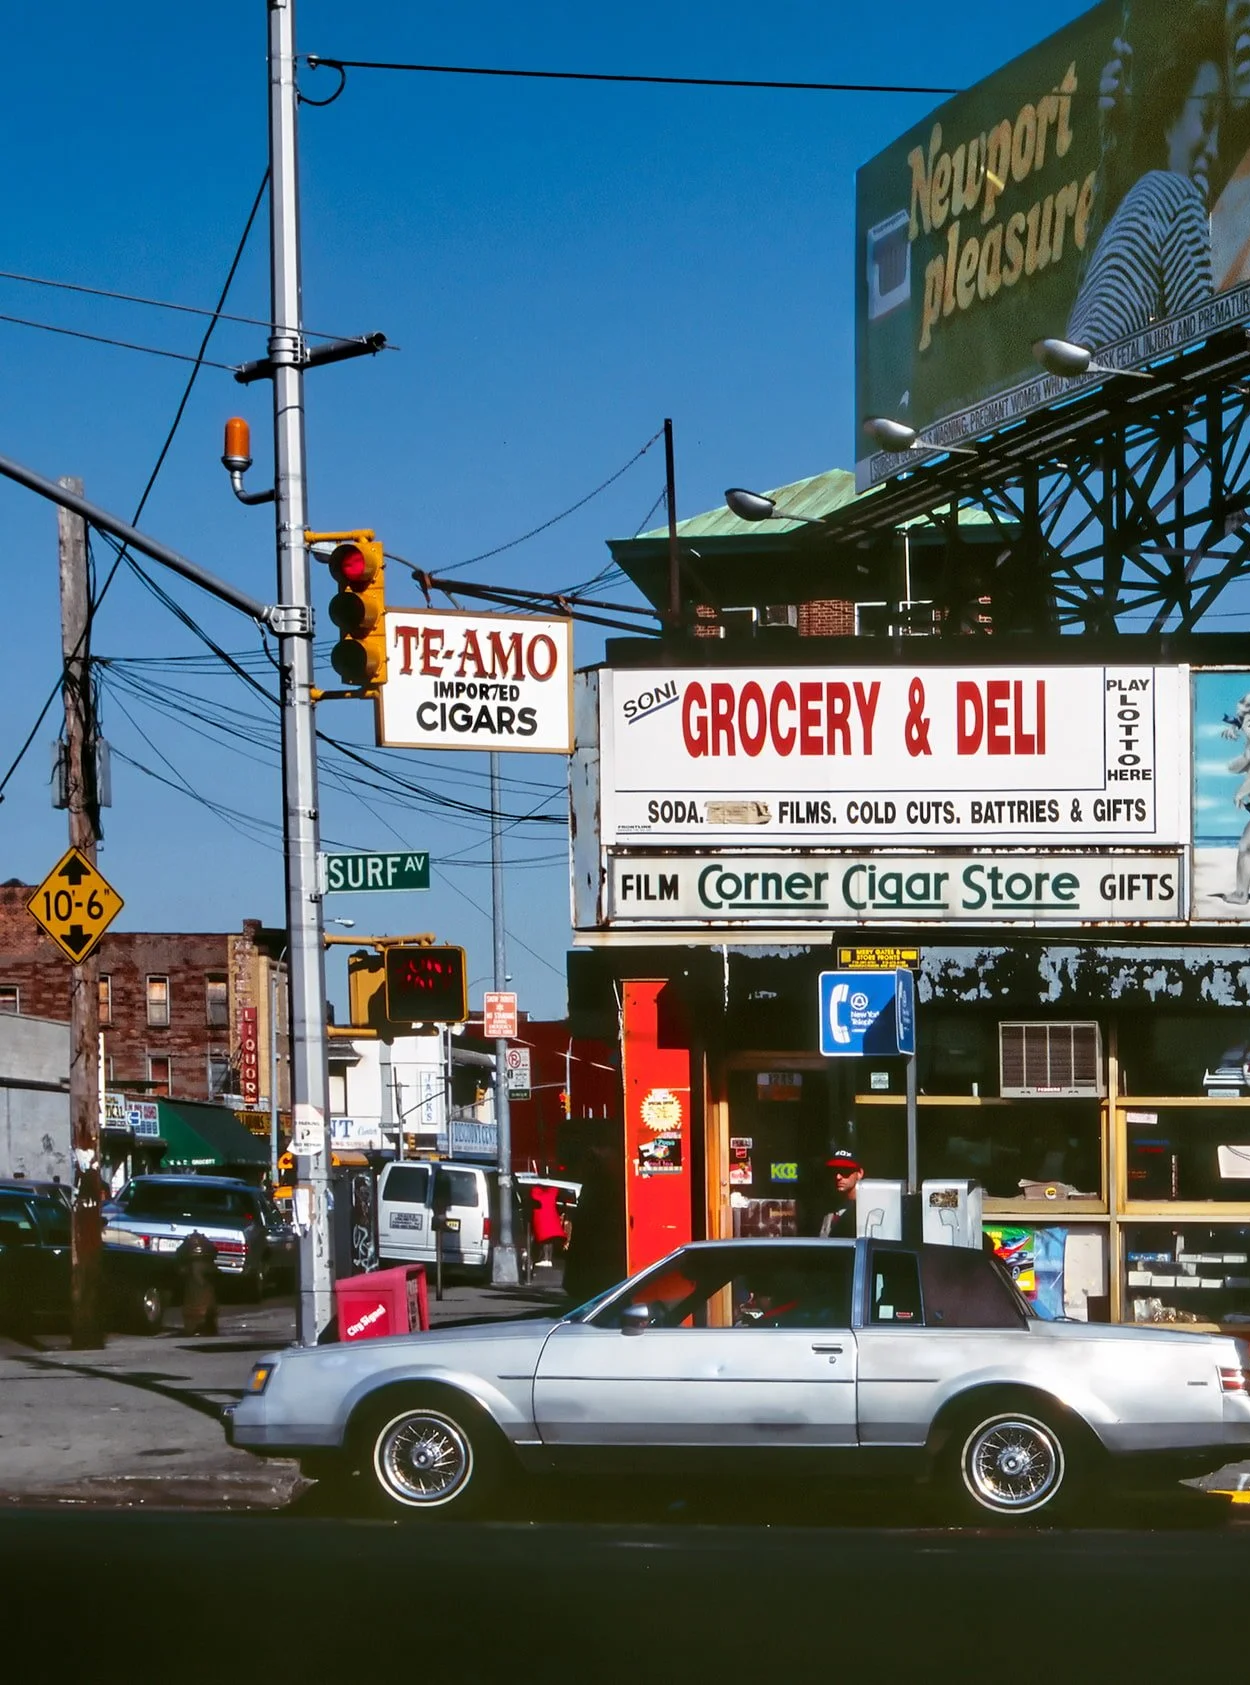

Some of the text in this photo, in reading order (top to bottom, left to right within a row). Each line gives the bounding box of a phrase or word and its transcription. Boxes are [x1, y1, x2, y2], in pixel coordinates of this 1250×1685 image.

[907, 60, 1078, 241] Newport
[1010, 383, 1041, 413] WOMEN
[1116, 341, 1142, 367] FETAL
[1143, 327, 1175, 357] INJURY
[1177, 319, 1196, 343] AND
[394, 625, 558, 682] TE-AMO
[433, 681, 520, 702] IMPORTED
[623, 680, 678, 720] SONI
[1106, 679, 1150, 692] PLAY
[416, 701, 538, 736] CIGARS
[682, 676, 1046, 758] GROCERY & DELI
[1107, 769, 1152, 781] HERE
[648, 798, 1147, 824] SODA. FILMS. COLD CUTS. BATTRIES & GIFTS
[329, 855, 425, 888] SURF AV
[621, 864, 1175, 910] FILM Corner Cigar Store GIFTS
[244, 1009, 257, 1094] LIQUOR
[347, 1304, 387, 1337] City Signal
